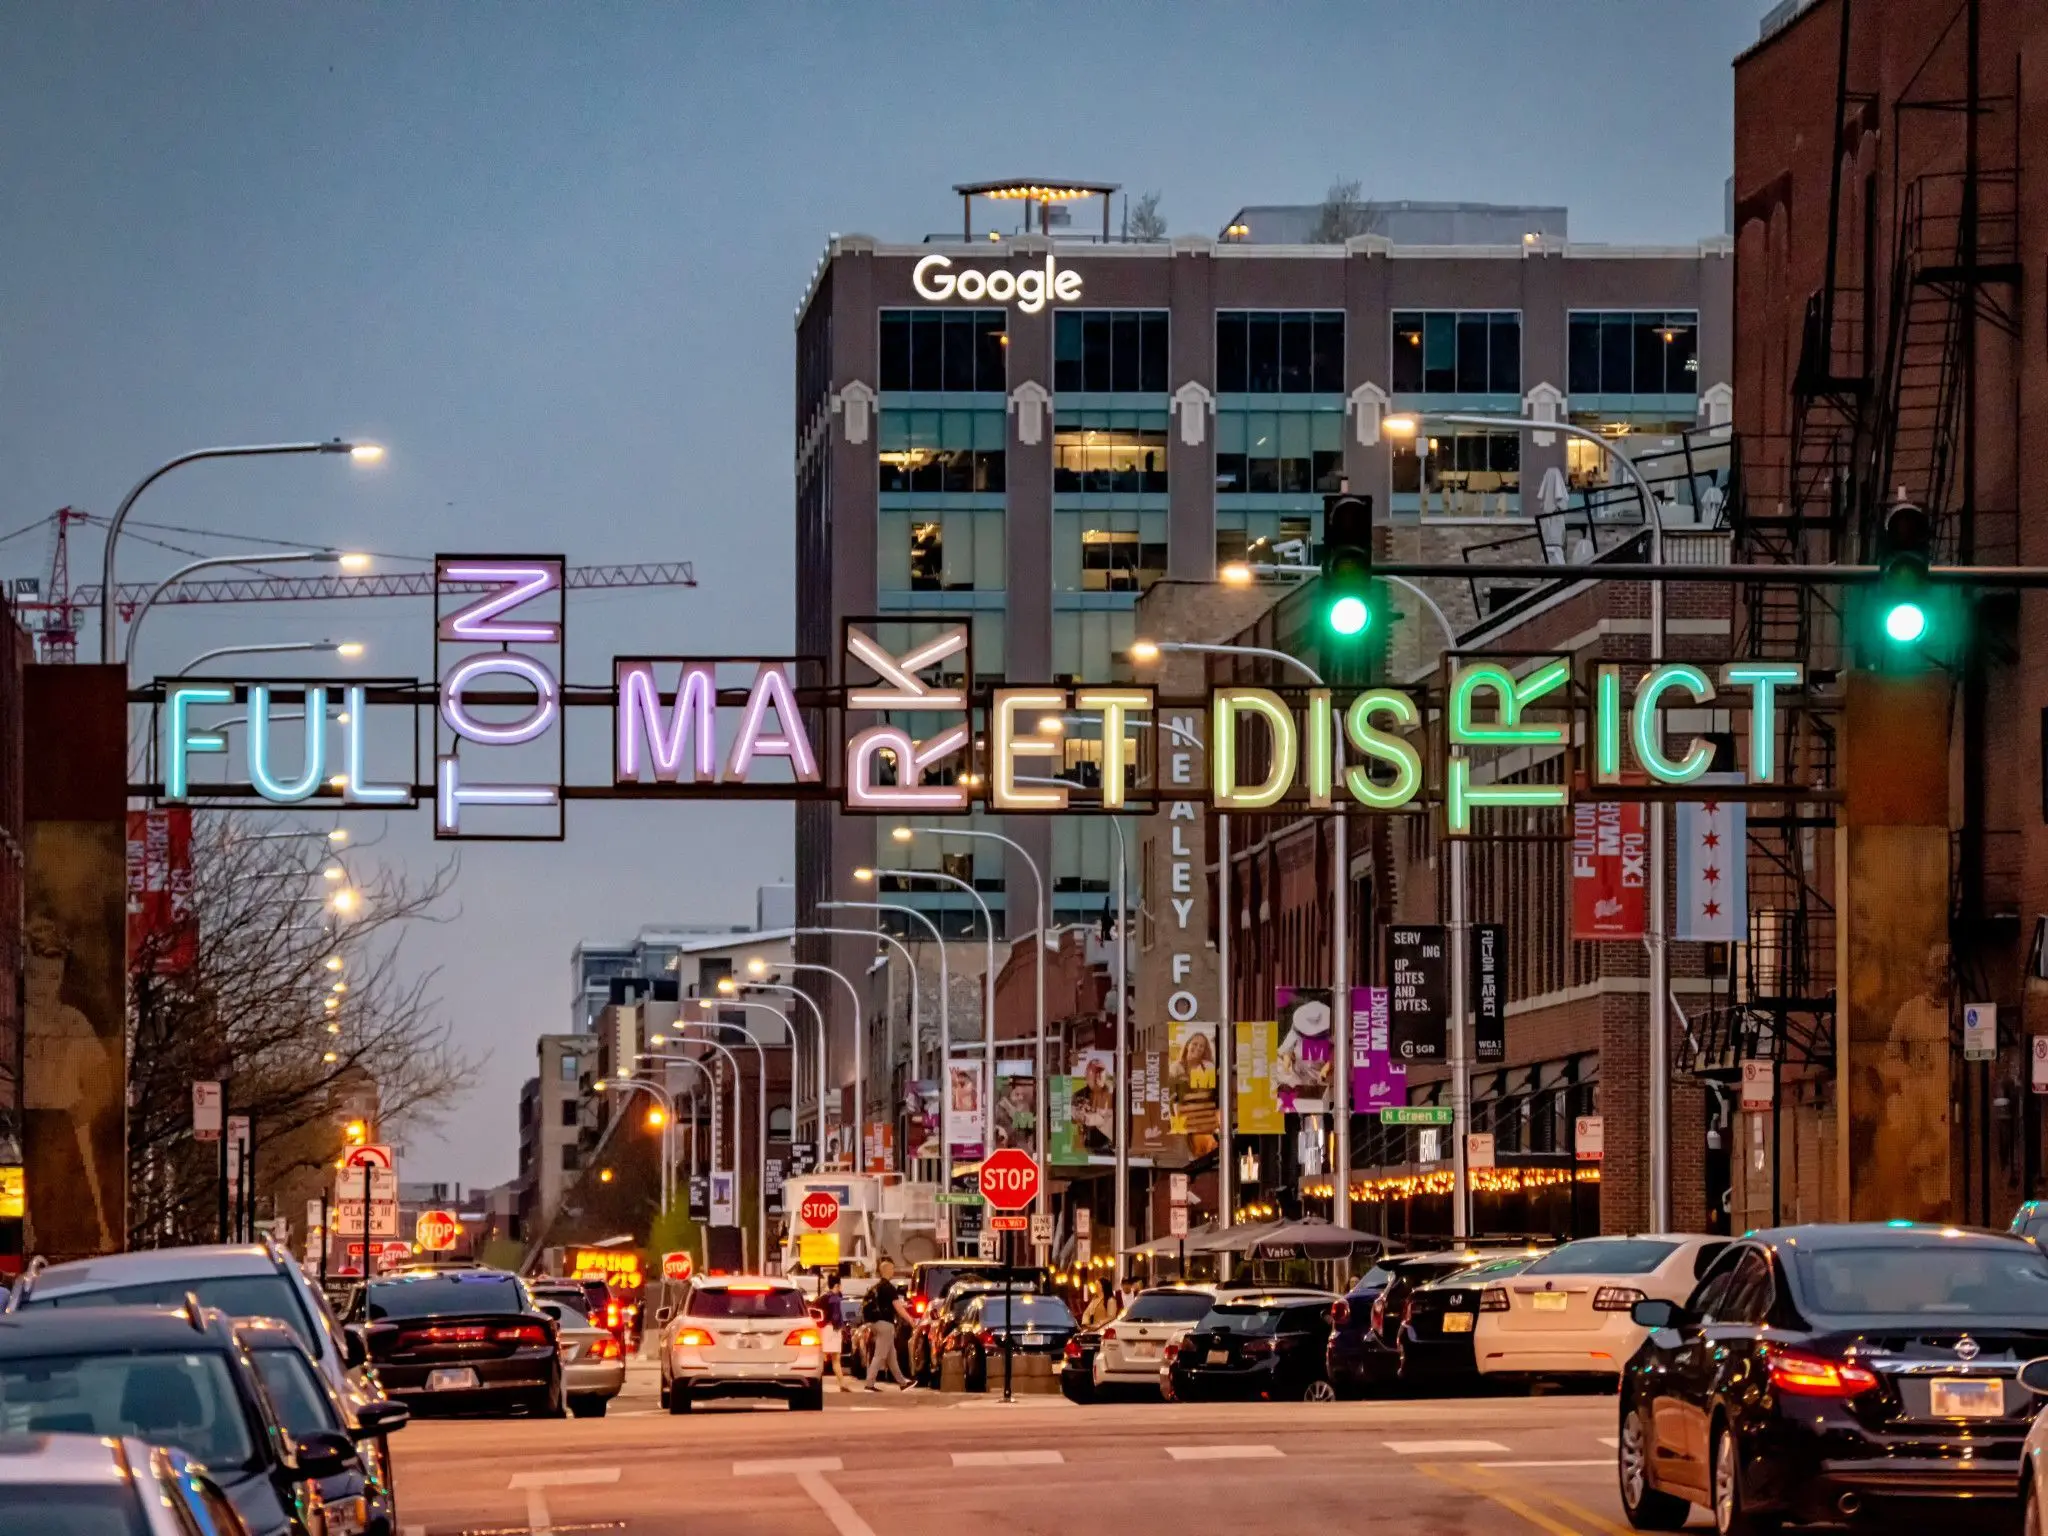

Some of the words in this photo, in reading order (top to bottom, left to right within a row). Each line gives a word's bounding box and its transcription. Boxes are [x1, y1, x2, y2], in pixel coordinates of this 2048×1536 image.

[913, 254, 1083, 313] Google
[1573, 802, 1596, 877] FULTON
[1622, 833, 1645, 887] EXPO
[1394, 932, 1421, 945] SERV
[1422, 945, 1440, 958] ING
[1481, 930, 1495, 972] FULTON
[1395, 959, 1409, 971] UP
[1395, 972, 1425, 985] BITES
[1394, 985, 1416, 998] AND
[1481, 974, 1497, 1018] MARKET
[1395, 999, 1431, 1012] BYTES.
[1371, 986, 1388, 1051] MARKET
[1353, 1010, 1371, 1068] FULTON
[1416, 1044, 1435, 1054] SGR
[1386, 1111, 1393, 1120] N
[1398, 1110, 1432, 1120] Green
[1437, 1111, 1446, 1120] St
[984, 1168, 1035, 1190] STOP
[343, 1206, 375, 1217] CLAS
[803, 1203, 836, 1219] STOP
[351, 1219, 382, 1230] TRCK
[994, 1219, 1006, 1227] ALL
[1009, 1219, 1023, 1227] WAY
[1034, 1225, 1050, 1233] WAY
[420, 1223, 453, 1239] STOP
[1266, 1247, 1296, 1258] Valet
[666, 1260, 690, 1274] STOP
